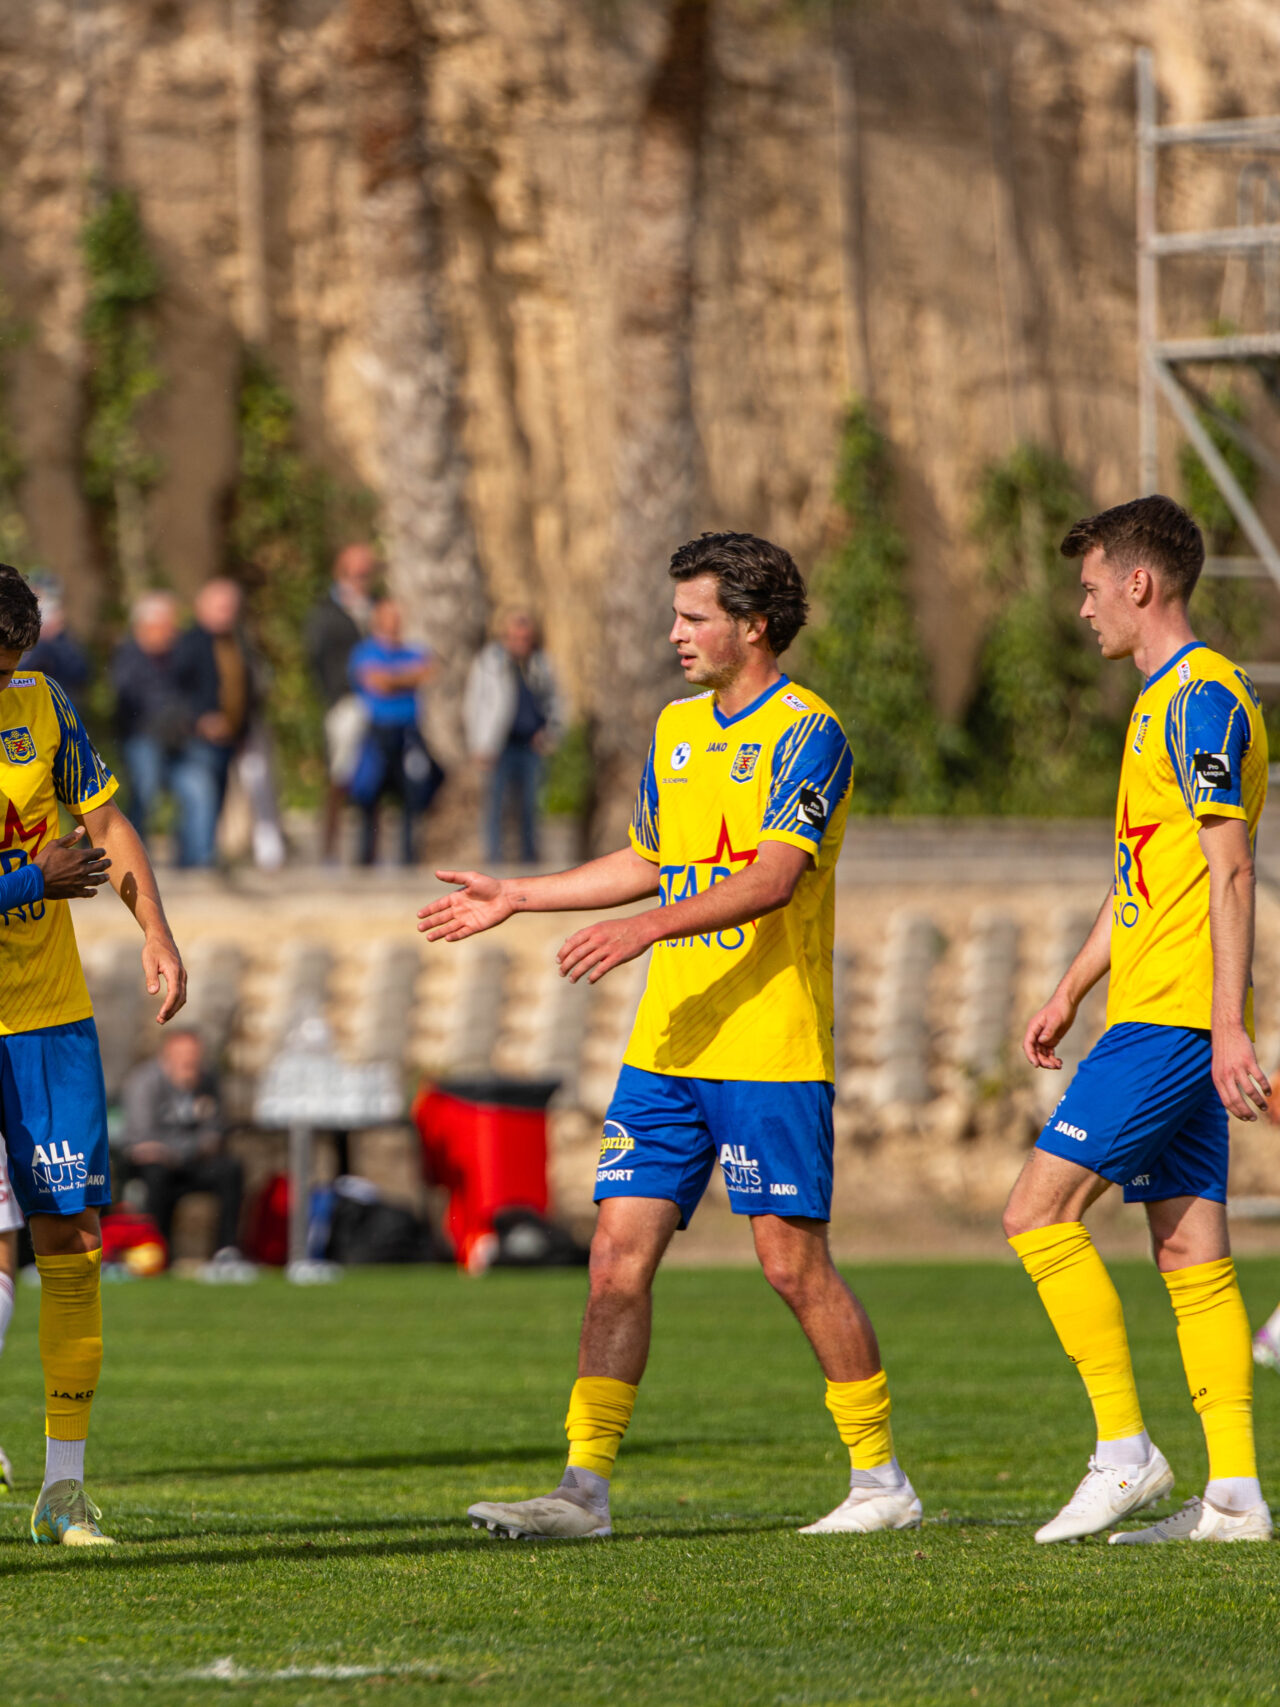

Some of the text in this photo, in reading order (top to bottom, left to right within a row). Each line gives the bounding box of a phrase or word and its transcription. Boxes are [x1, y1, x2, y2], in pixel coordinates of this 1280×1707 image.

[706, 742, 728, 752] JAKO
[1207, 763, 1220, 771] Pro
[1054, 1120, 1088, 1142] JAKO
[31, 1139, 84, 1167] ALL.
[720, 1143, 759, 1167] ALL.
[32, 1160, 88, 1186] NUTS
[721, 1165, 762, 1186] NUTS
[50, 1389, 94, 1401] JAKO
